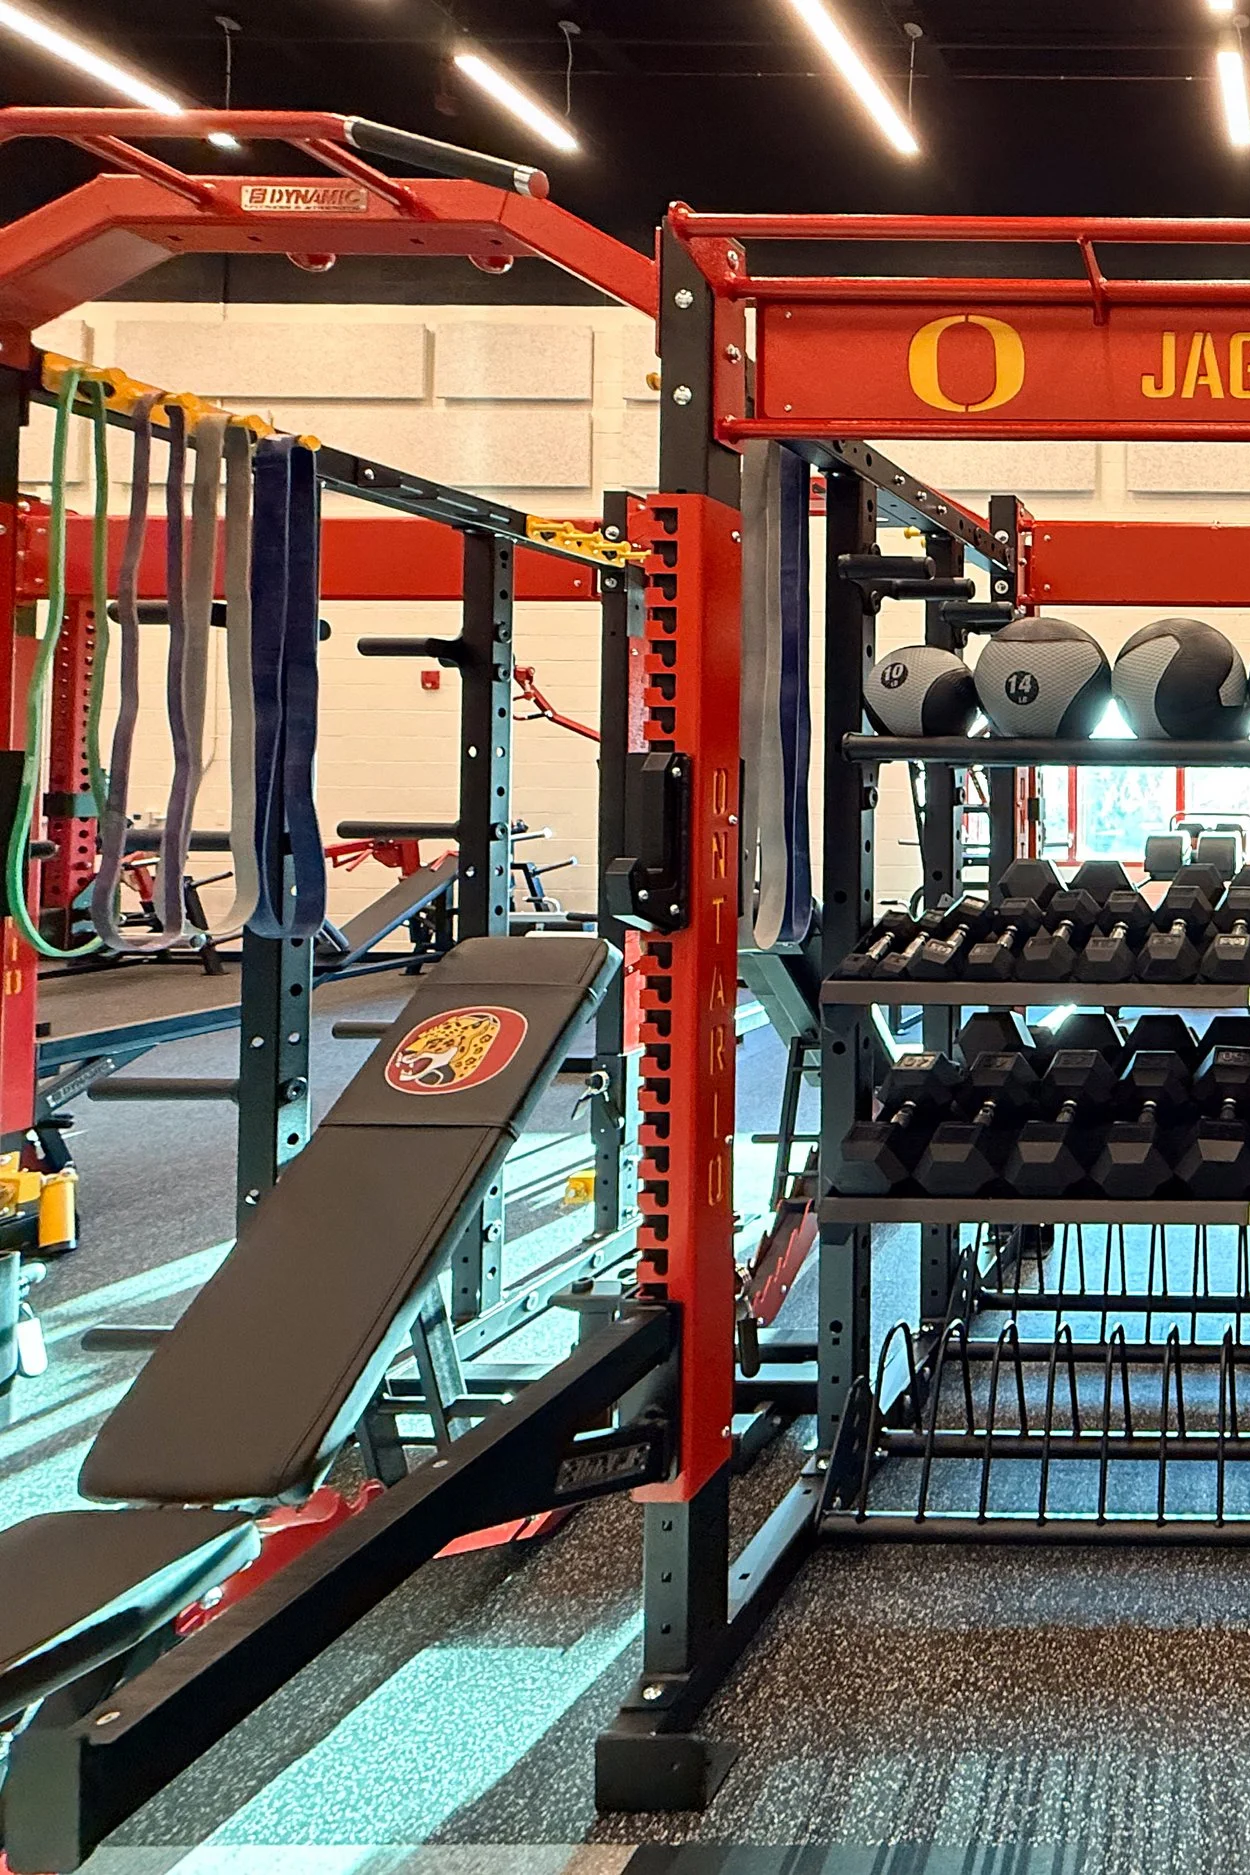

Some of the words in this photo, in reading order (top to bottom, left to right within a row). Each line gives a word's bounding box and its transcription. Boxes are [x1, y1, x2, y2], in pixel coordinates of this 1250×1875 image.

[269, 188, 361, 205] DYNAMIC
[908, 314, 1025, 413] O
[884, 664, 904, 681] 10
[1008, 674, 1031, 693] 14
[708, 767, 729, 1207] ONTARIO
